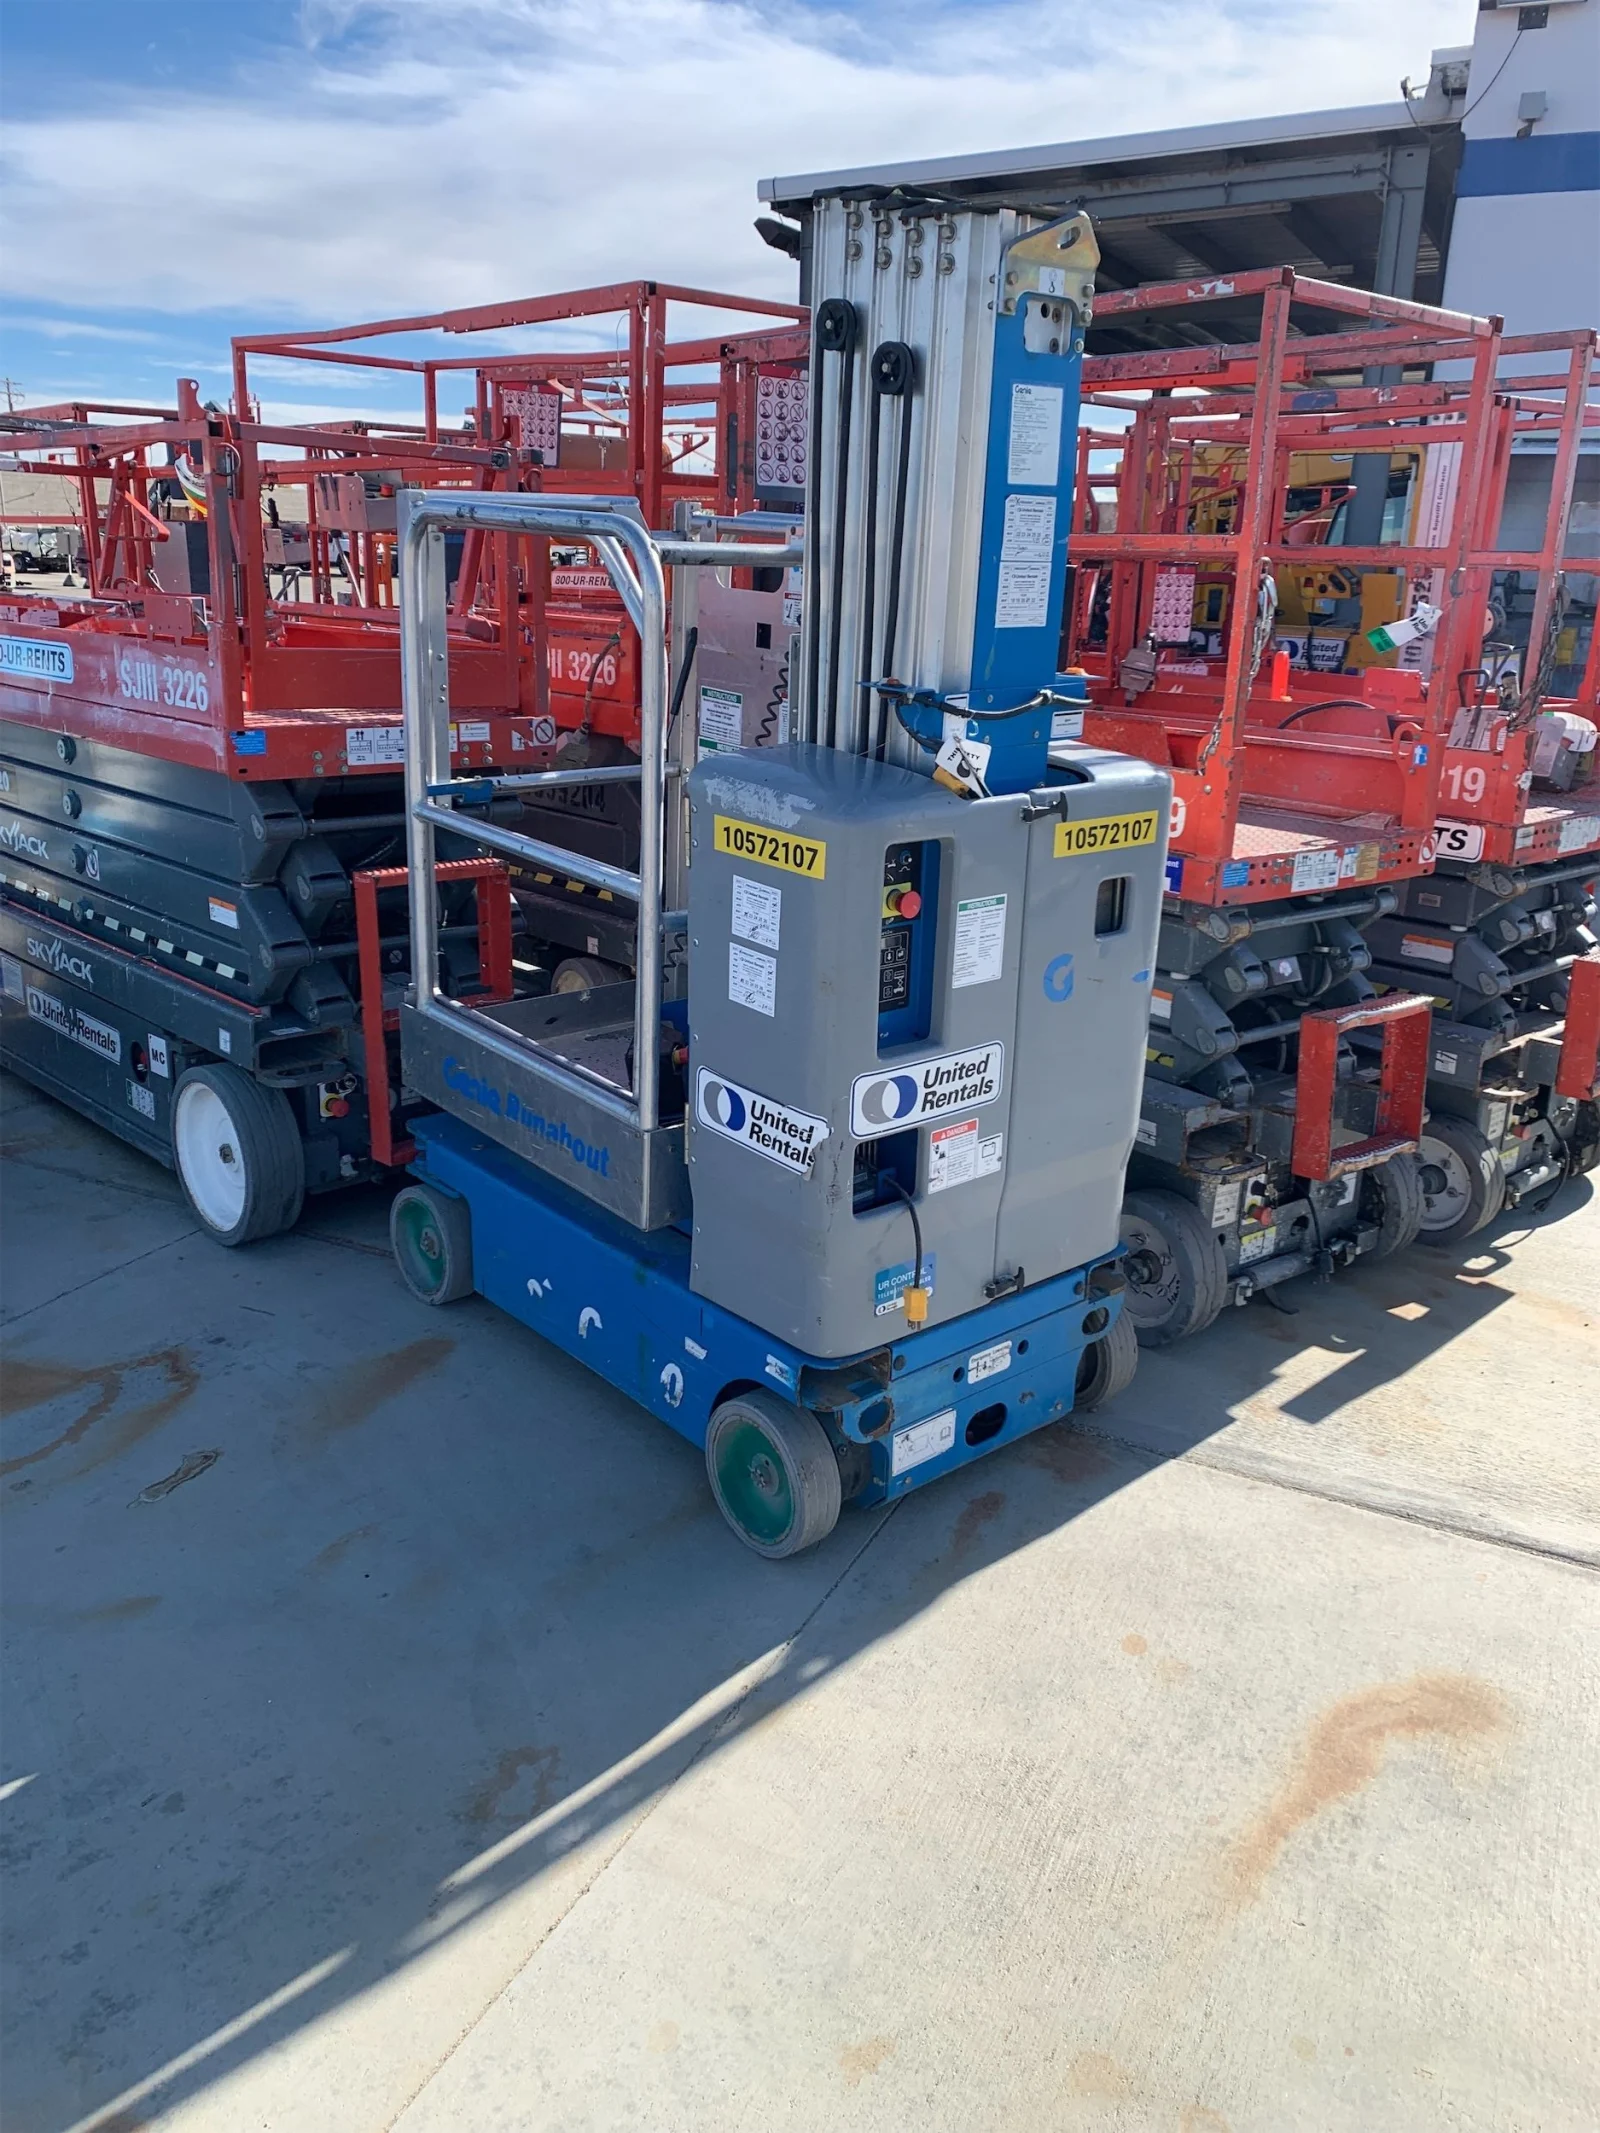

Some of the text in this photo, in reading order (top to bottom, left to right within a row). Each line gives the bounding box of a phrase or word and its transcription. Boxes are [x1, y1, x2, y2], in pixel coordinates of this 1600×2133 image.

[568, 651, 616, 686] 3226
[1300, 651, 1342, 662] Rntals
[163, 666, 208, 712] 3226
[723, 826, 819, 871] 10572107
[1064, 818, 1153, 851] 10572107
[27, 937, 94, 984] SKYJACK
[77, 1019, 117, 1054] Rentals
[151, 1052, 166, 1065] MC
[923, 1054, 990, 1089] United
[921, 1077, 994, 1113] Rentals
[750, 1100, 815, 1144] United
[947, 1124, 969, 1138] DANGER
[748, 1121, 815, 1168] Rentals
[878, 1266, 928, 1291] UR CONTL
